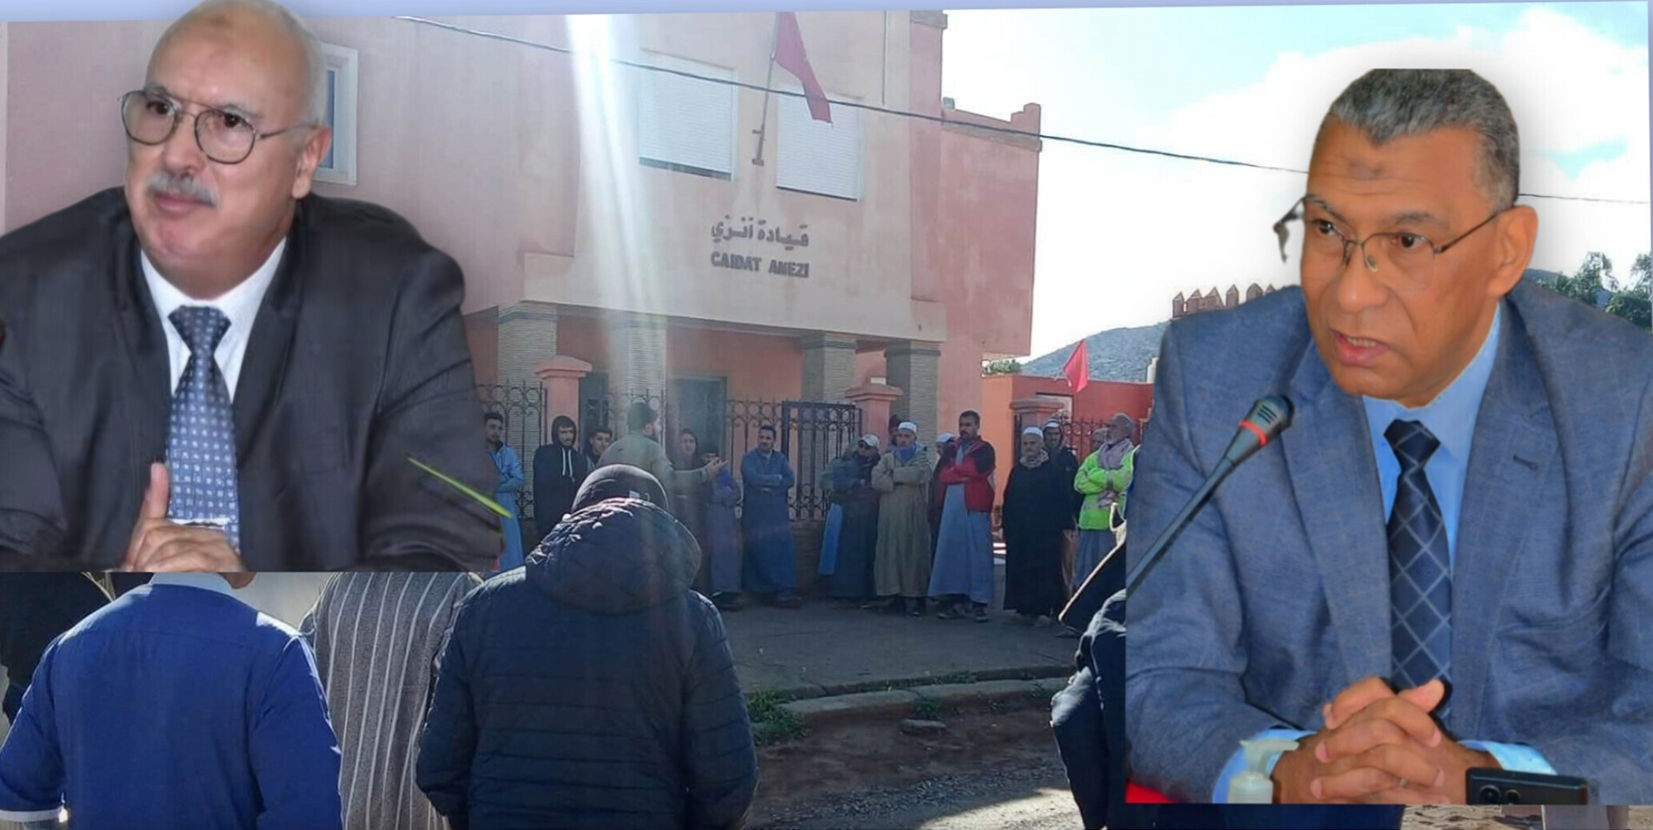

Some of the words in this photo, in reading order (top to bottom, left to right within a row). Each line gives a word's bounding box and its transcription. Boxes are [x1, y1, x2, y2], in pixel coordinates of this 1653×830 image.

[757, 219, 809, 251] قيادة
[710, 251, 762, 272] CAIDAT
[768, 260, 810, 278] ANEZI
